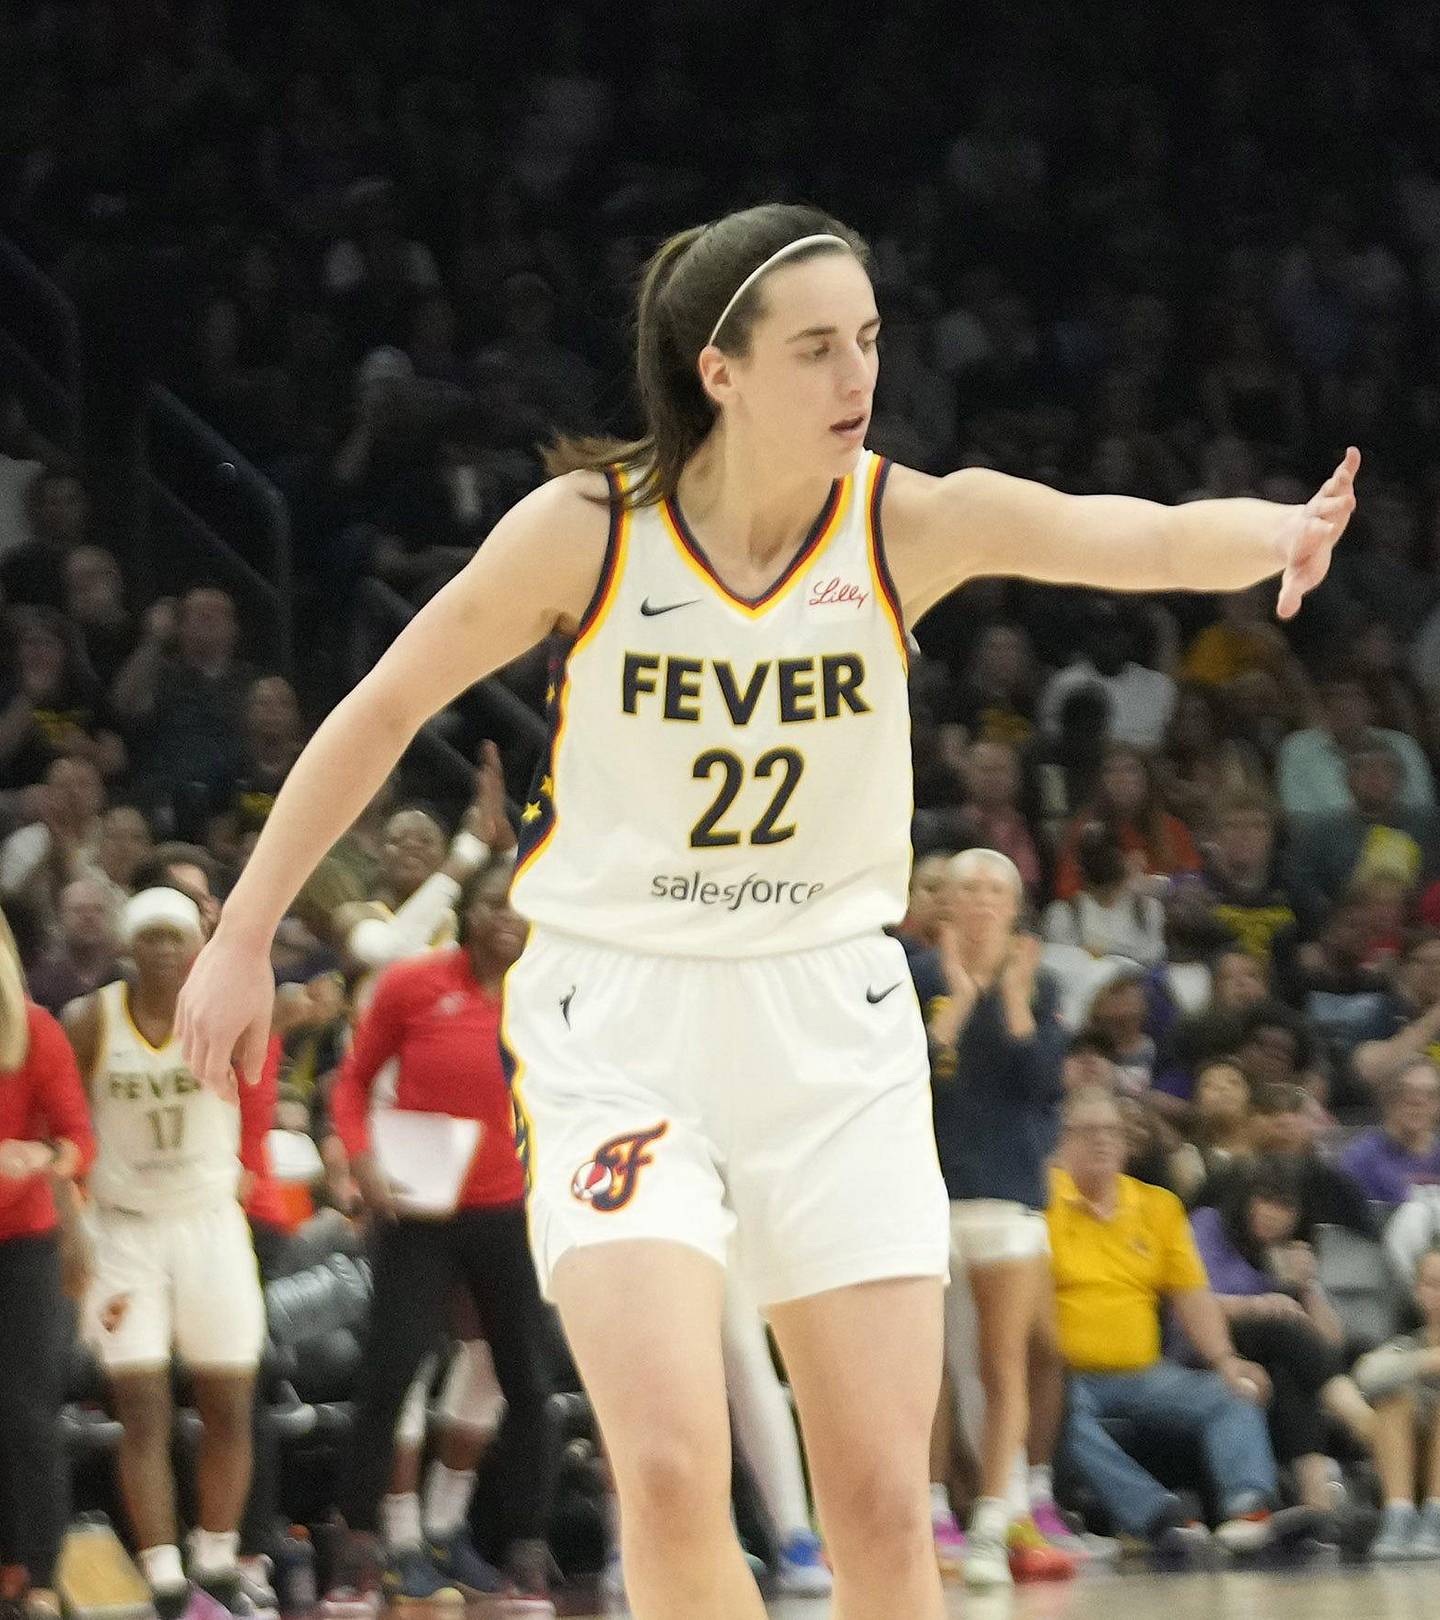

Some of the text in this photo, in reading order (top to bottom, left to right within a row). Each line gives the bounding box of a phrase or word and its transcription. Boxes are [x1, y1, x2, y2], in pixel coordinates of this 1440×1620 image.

[810, 577, 870, 609] Lilly
[621, 652, 872, 726] FEVER
[688, 747, 808, 850] 22
[651, 870, 824, 911] salesforce
[147, 1105, 185, 1151] 17
